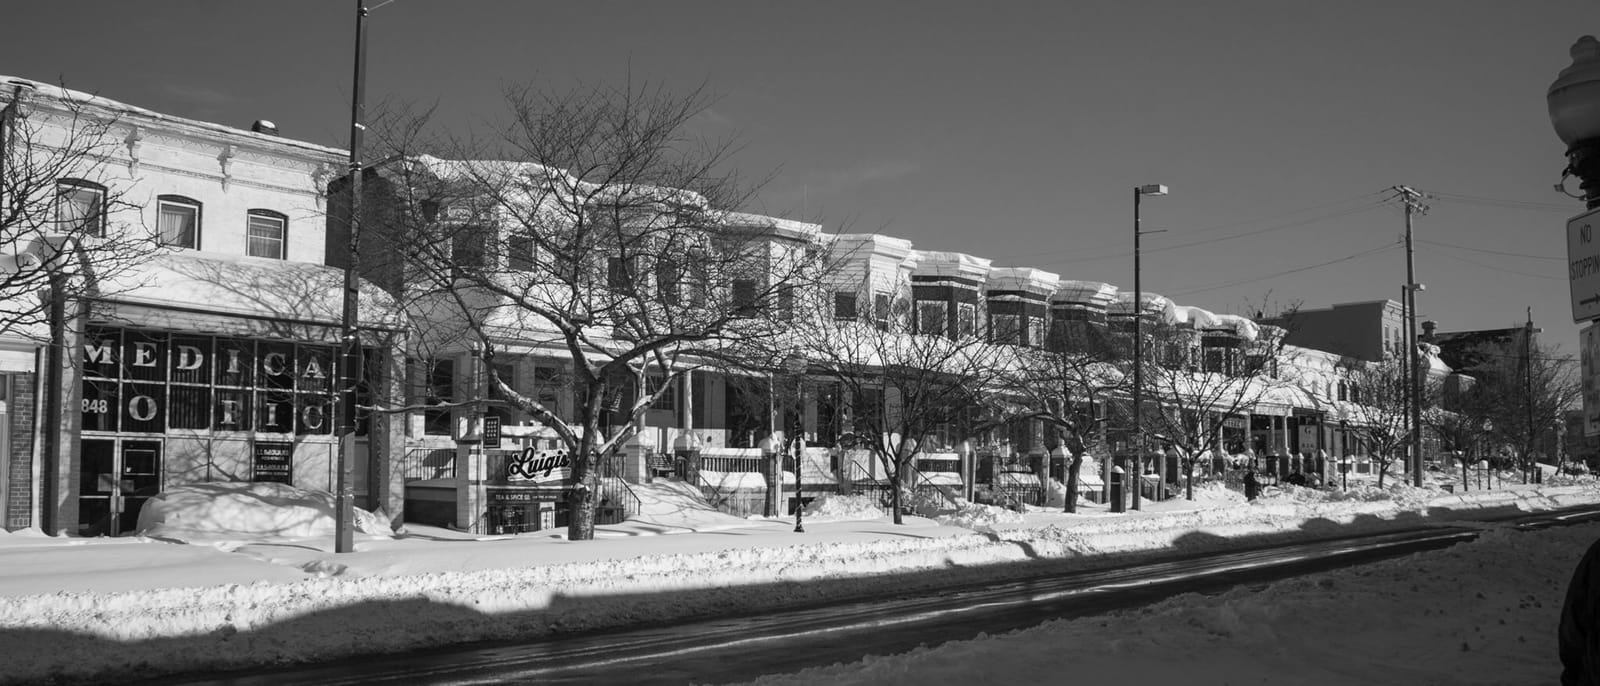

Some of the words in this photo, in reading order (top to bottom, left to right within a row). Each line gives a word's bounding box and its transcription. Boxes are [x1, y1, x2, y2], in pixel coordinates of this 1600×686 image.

[1580, 224, 1592, 246] NO
[1571, 254, 1600, 280] STOPPIN
[83, 338, 326, 379] MEDICA
[81, 398, 108, 414] 848
